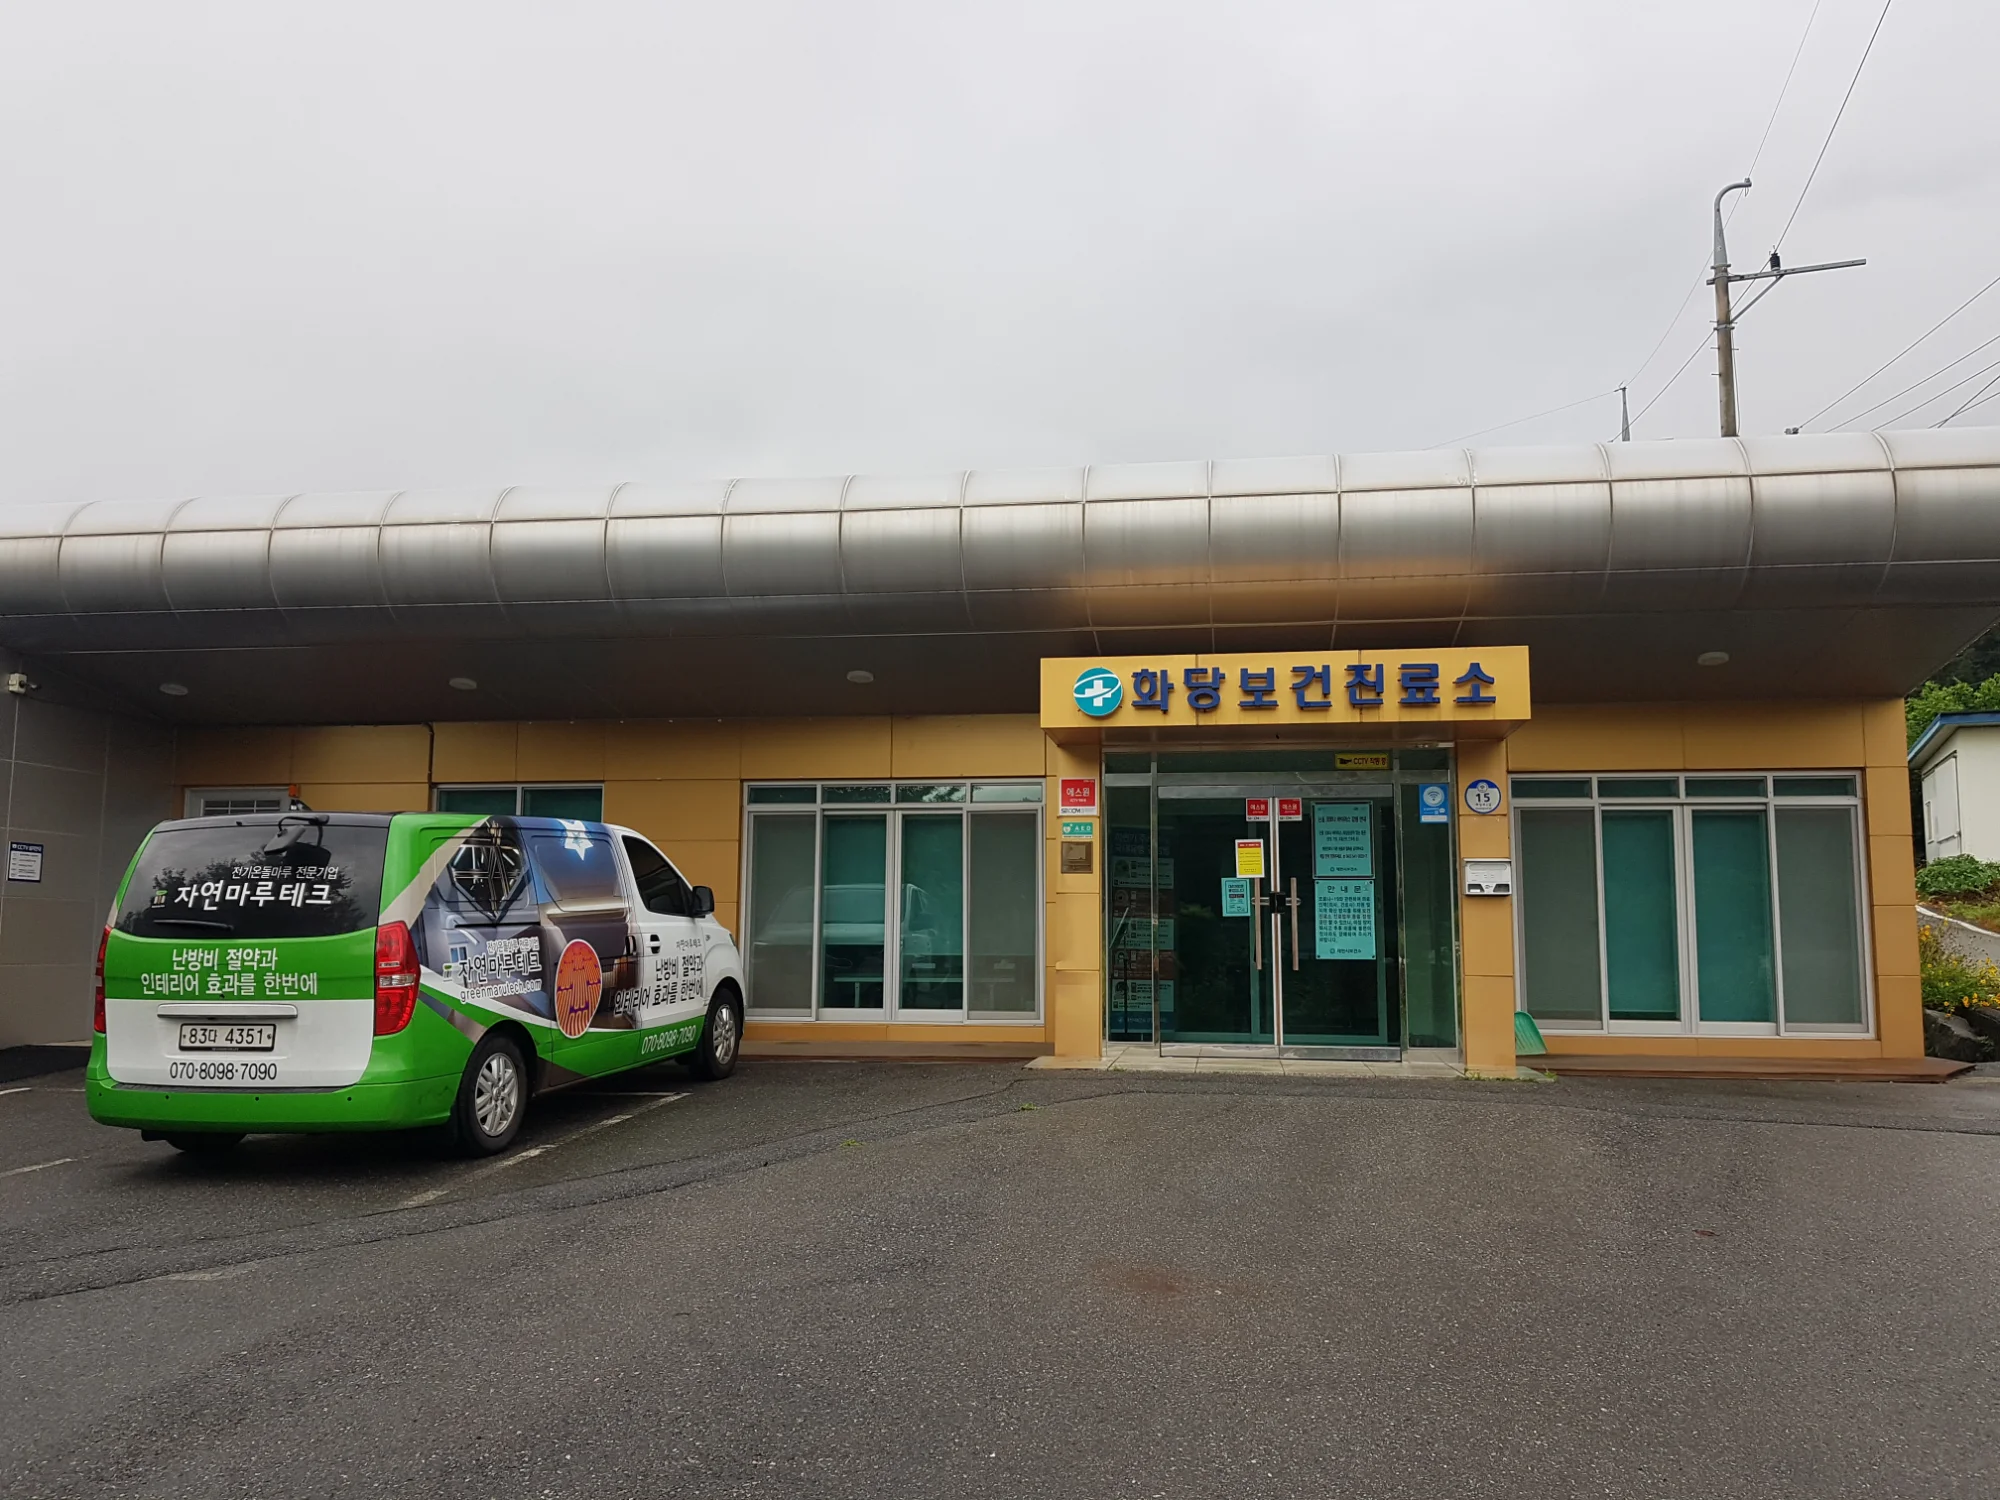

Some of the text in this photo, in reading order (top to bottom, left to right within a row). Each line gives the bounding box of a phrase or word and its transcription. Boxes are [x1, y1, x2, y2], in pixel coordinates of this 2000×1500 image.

[1130, 662, 1497, 714] 화당보건진료소
[1066, 787, 1090, 797] 에스원
[1476, 793, 1490, 802] 15
[232, 865, 339, 879] 전기온돌마루 전문기업
[174, 880, 332, 911] 자연마루테크
[172, 948, 278, 971] 난방비 절약과
[458, 953, 542, 983] 자연마루테크
[656, 956, 678, 981] 난방비
[141, 972, 317, 996] 인테리어 효과를 한번에
[460, 979, 542, 1003] greenmarutech.com
[614, 986, 651, 1015] 인테리어
[652, 981, 677, 1006] 효과를
[189, 1028, 263, 1044] 83다 4351
